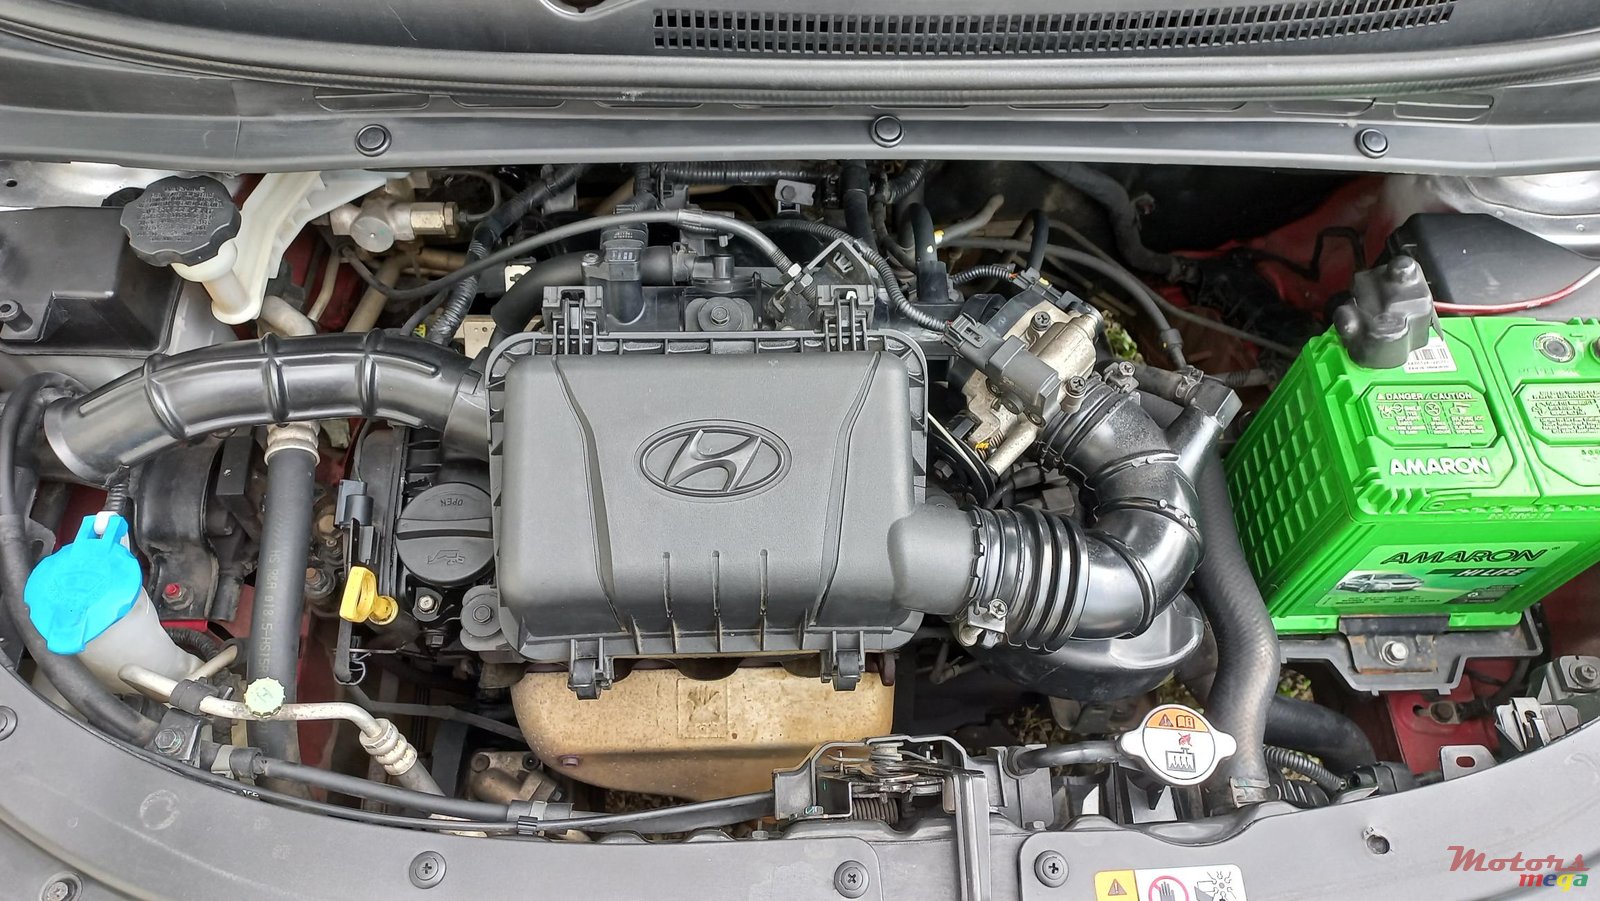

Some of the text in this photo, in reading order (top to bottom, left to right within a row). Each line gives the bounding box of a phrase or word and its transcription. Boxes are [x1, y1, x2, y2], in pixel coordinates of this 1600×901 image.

[1385, 393, 1424, 401] DANGER
[1431, 392, 1473, 401] CAUTION
[1389, 457, 1492, 476] AMARON
[440, 497, 464, 507] OPEN
[1380, 549, 1549, 565] AMARON
